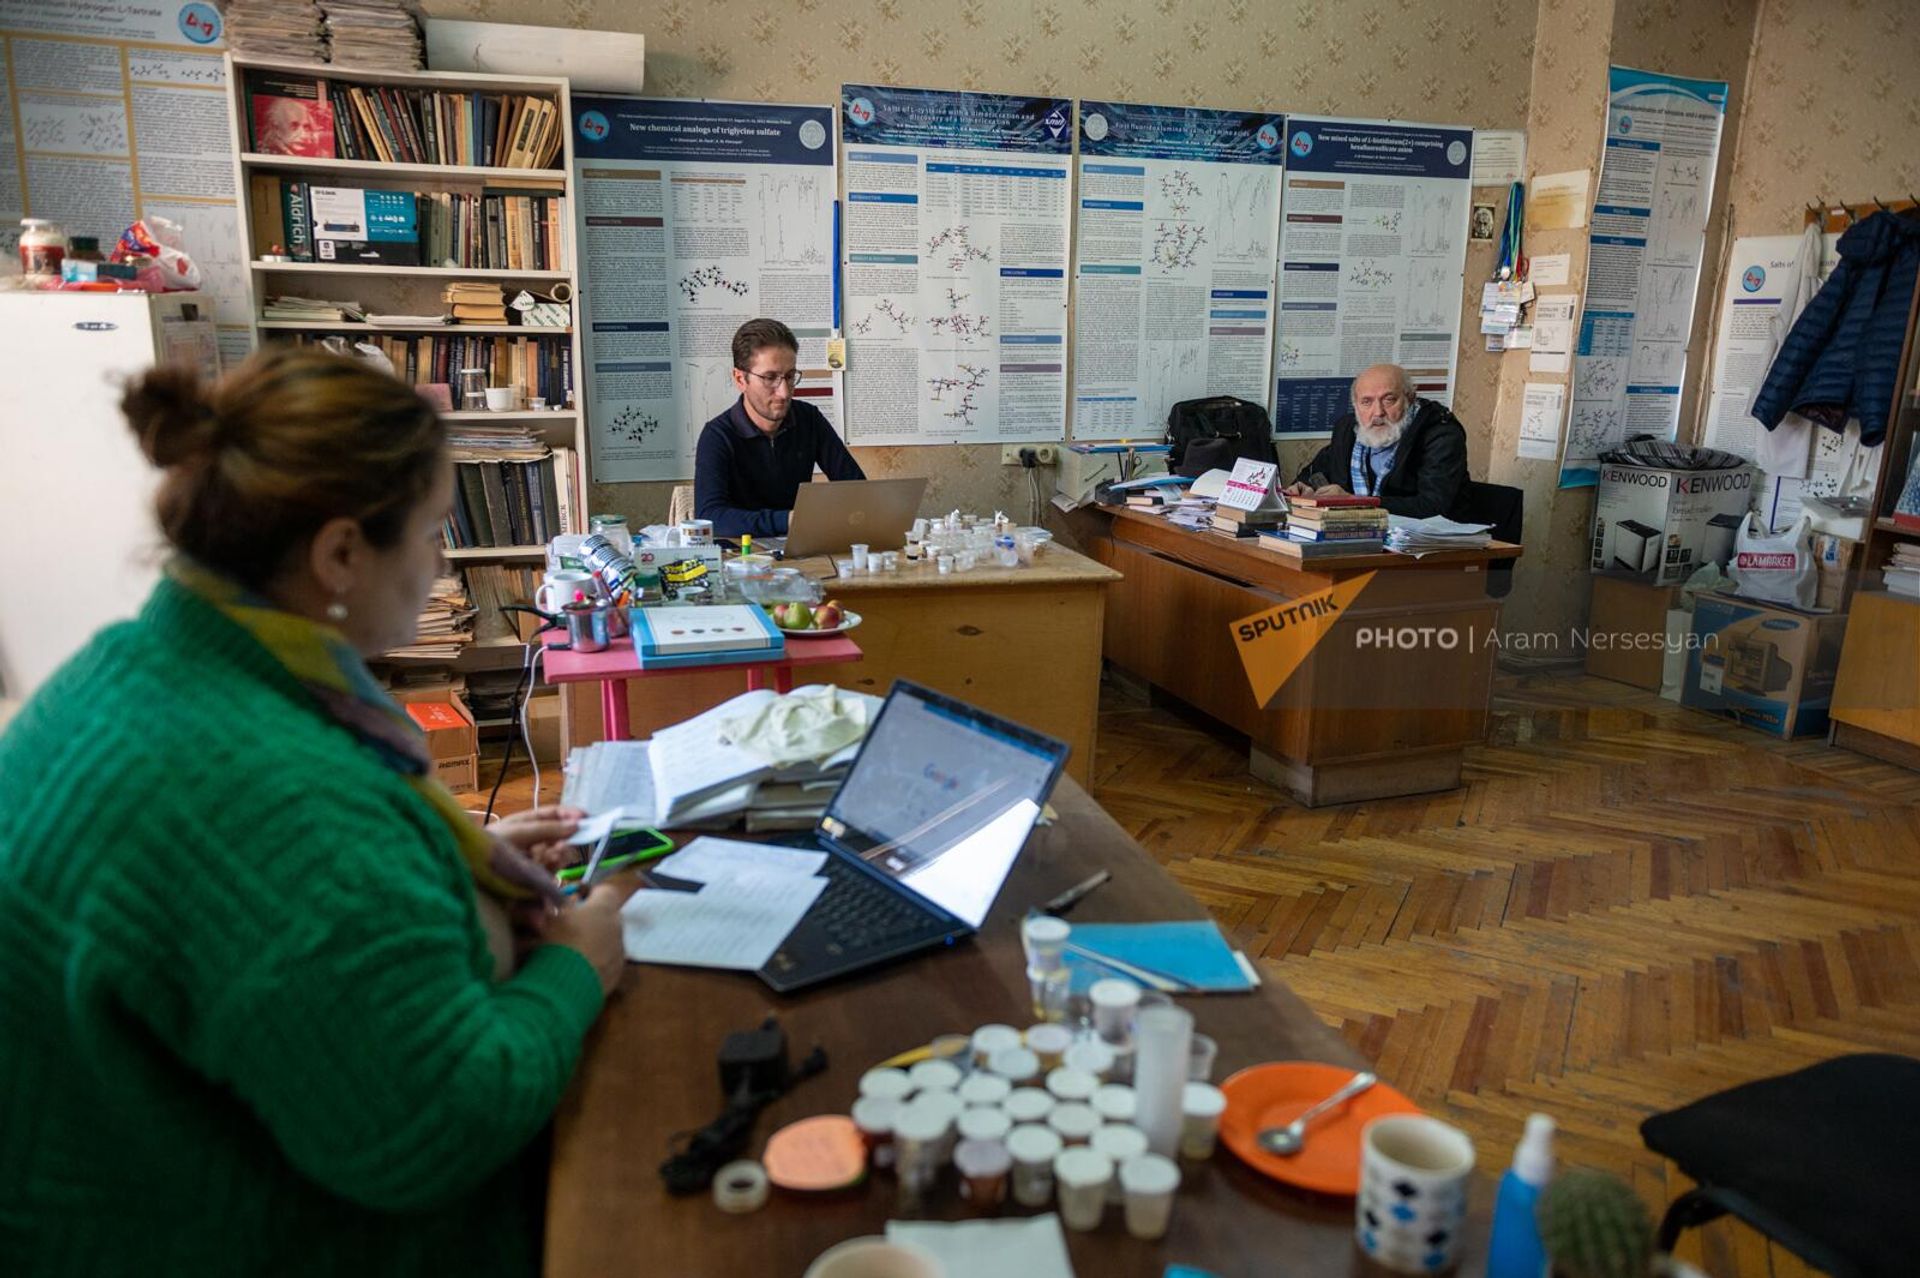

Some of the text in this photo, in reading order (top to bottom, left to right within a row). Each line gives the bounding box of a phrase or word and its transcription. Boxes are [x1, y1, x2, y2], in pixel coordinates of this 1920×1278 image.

[630, 123, 781, 136] New chemical analogs of triglycine sulfate
[290, 194, 306, 245] Aldrich
[1602, 469, 1667, 488] KENWOOD
[1676, 473, 1750, 495] KENWOOD
